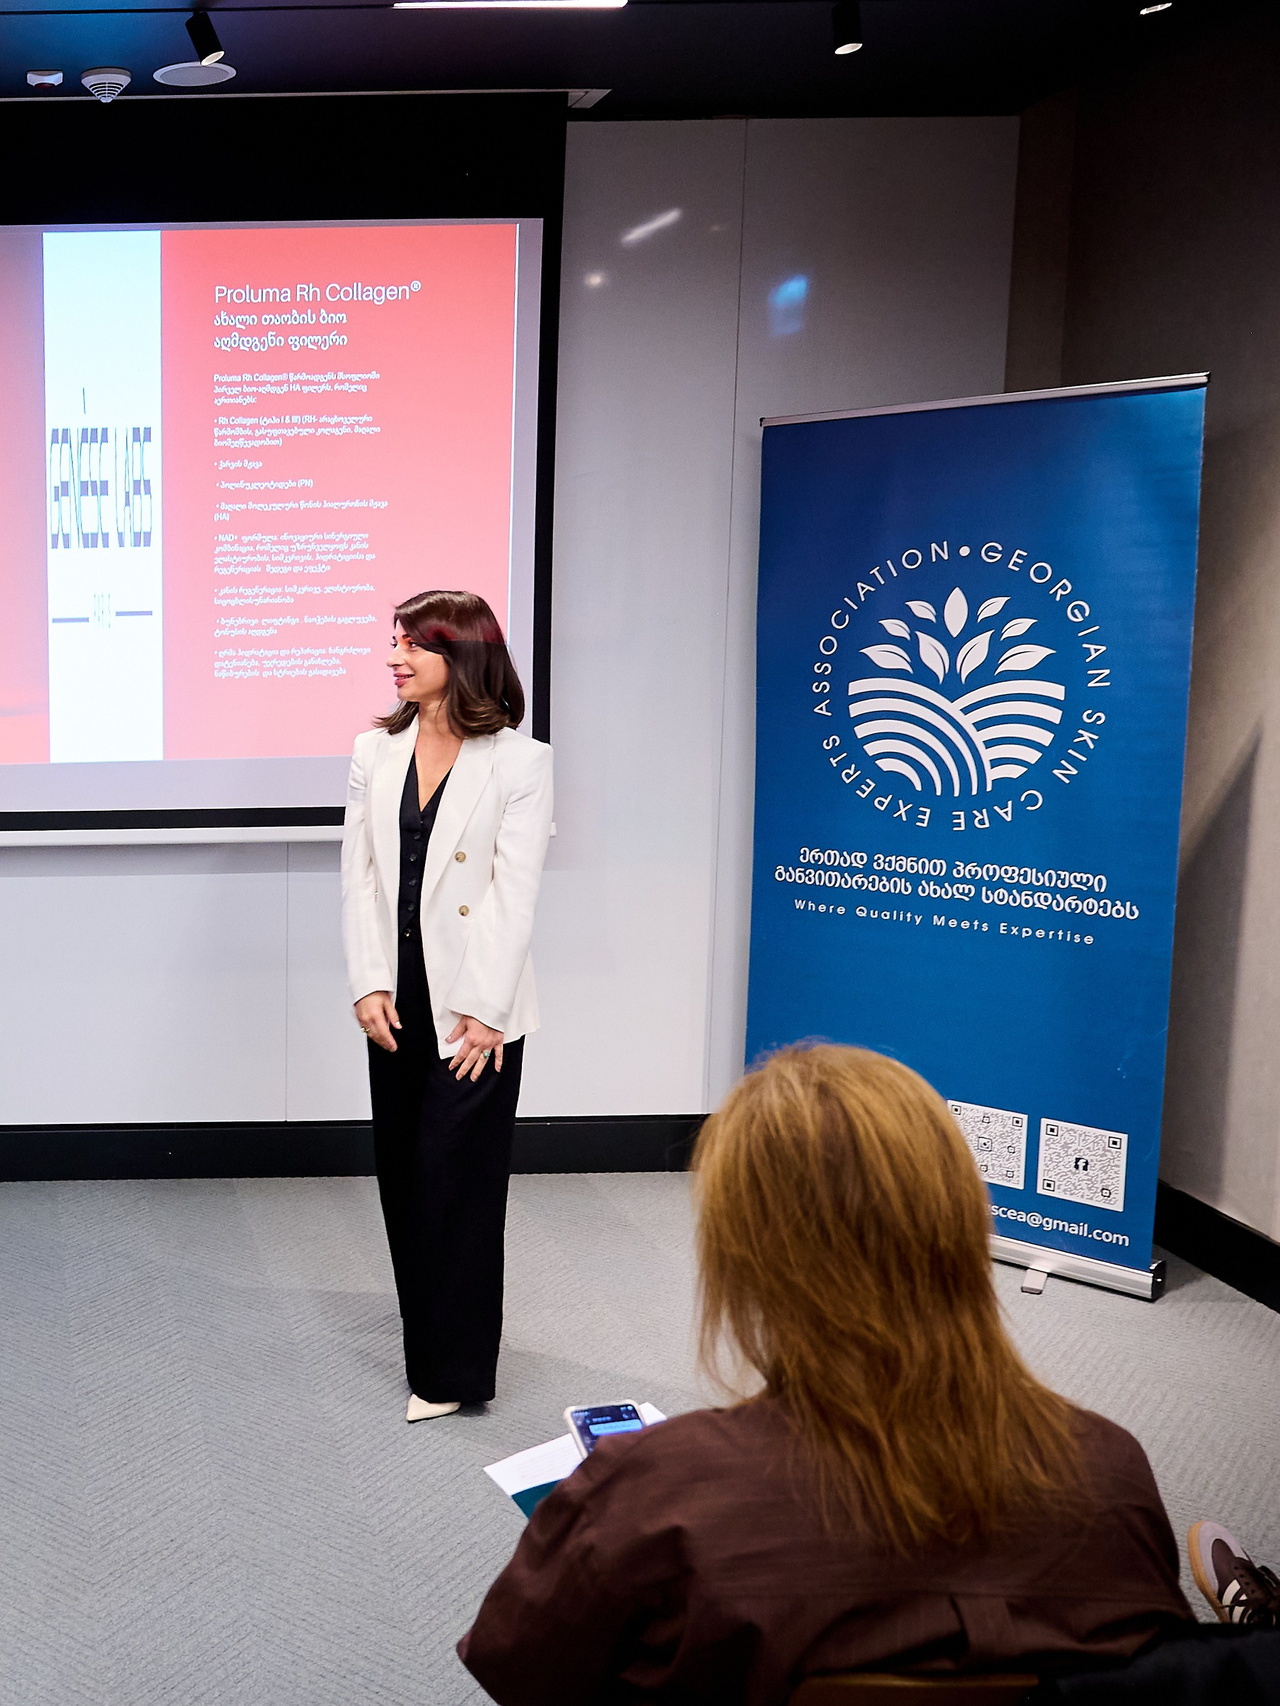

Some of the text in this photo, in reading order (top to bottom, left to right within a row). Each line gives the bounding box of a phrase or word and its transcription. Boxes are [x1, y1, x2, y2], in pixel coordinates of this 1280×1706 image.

[214, 284, 291, 304] Proluma
[296, 283, 321, 302] Rh
[213, 308, 348, 330] ახალი თაობის ბიო
[213, 331, 348, 352] აღმდგენი ფილერი
[213, 374, 241, 382] Proluma
[242, 373, 253, 382] Rh
[289, 383, 301, 391] HA
[218, 416, 229, 425] Rh
[229, 416, 259, 426] Collagen
[285, 415, 291, 424] &
[214, 512, 230, 522] (HA)
[812, 540, 1112, 832] GEORGIAN SKIN CARE EXPERTS ASSOCIATION
[799, 846, 1108, 893] ერთად ვქმნით პროფესიული
[774, 865, 1140, 920] განვითარების ახალ სტანდარტებს
[793, 898, 1095, 945] Where Quality Meets Expertise
[987, 1203, 1130, 1246] scea@gmail.com
